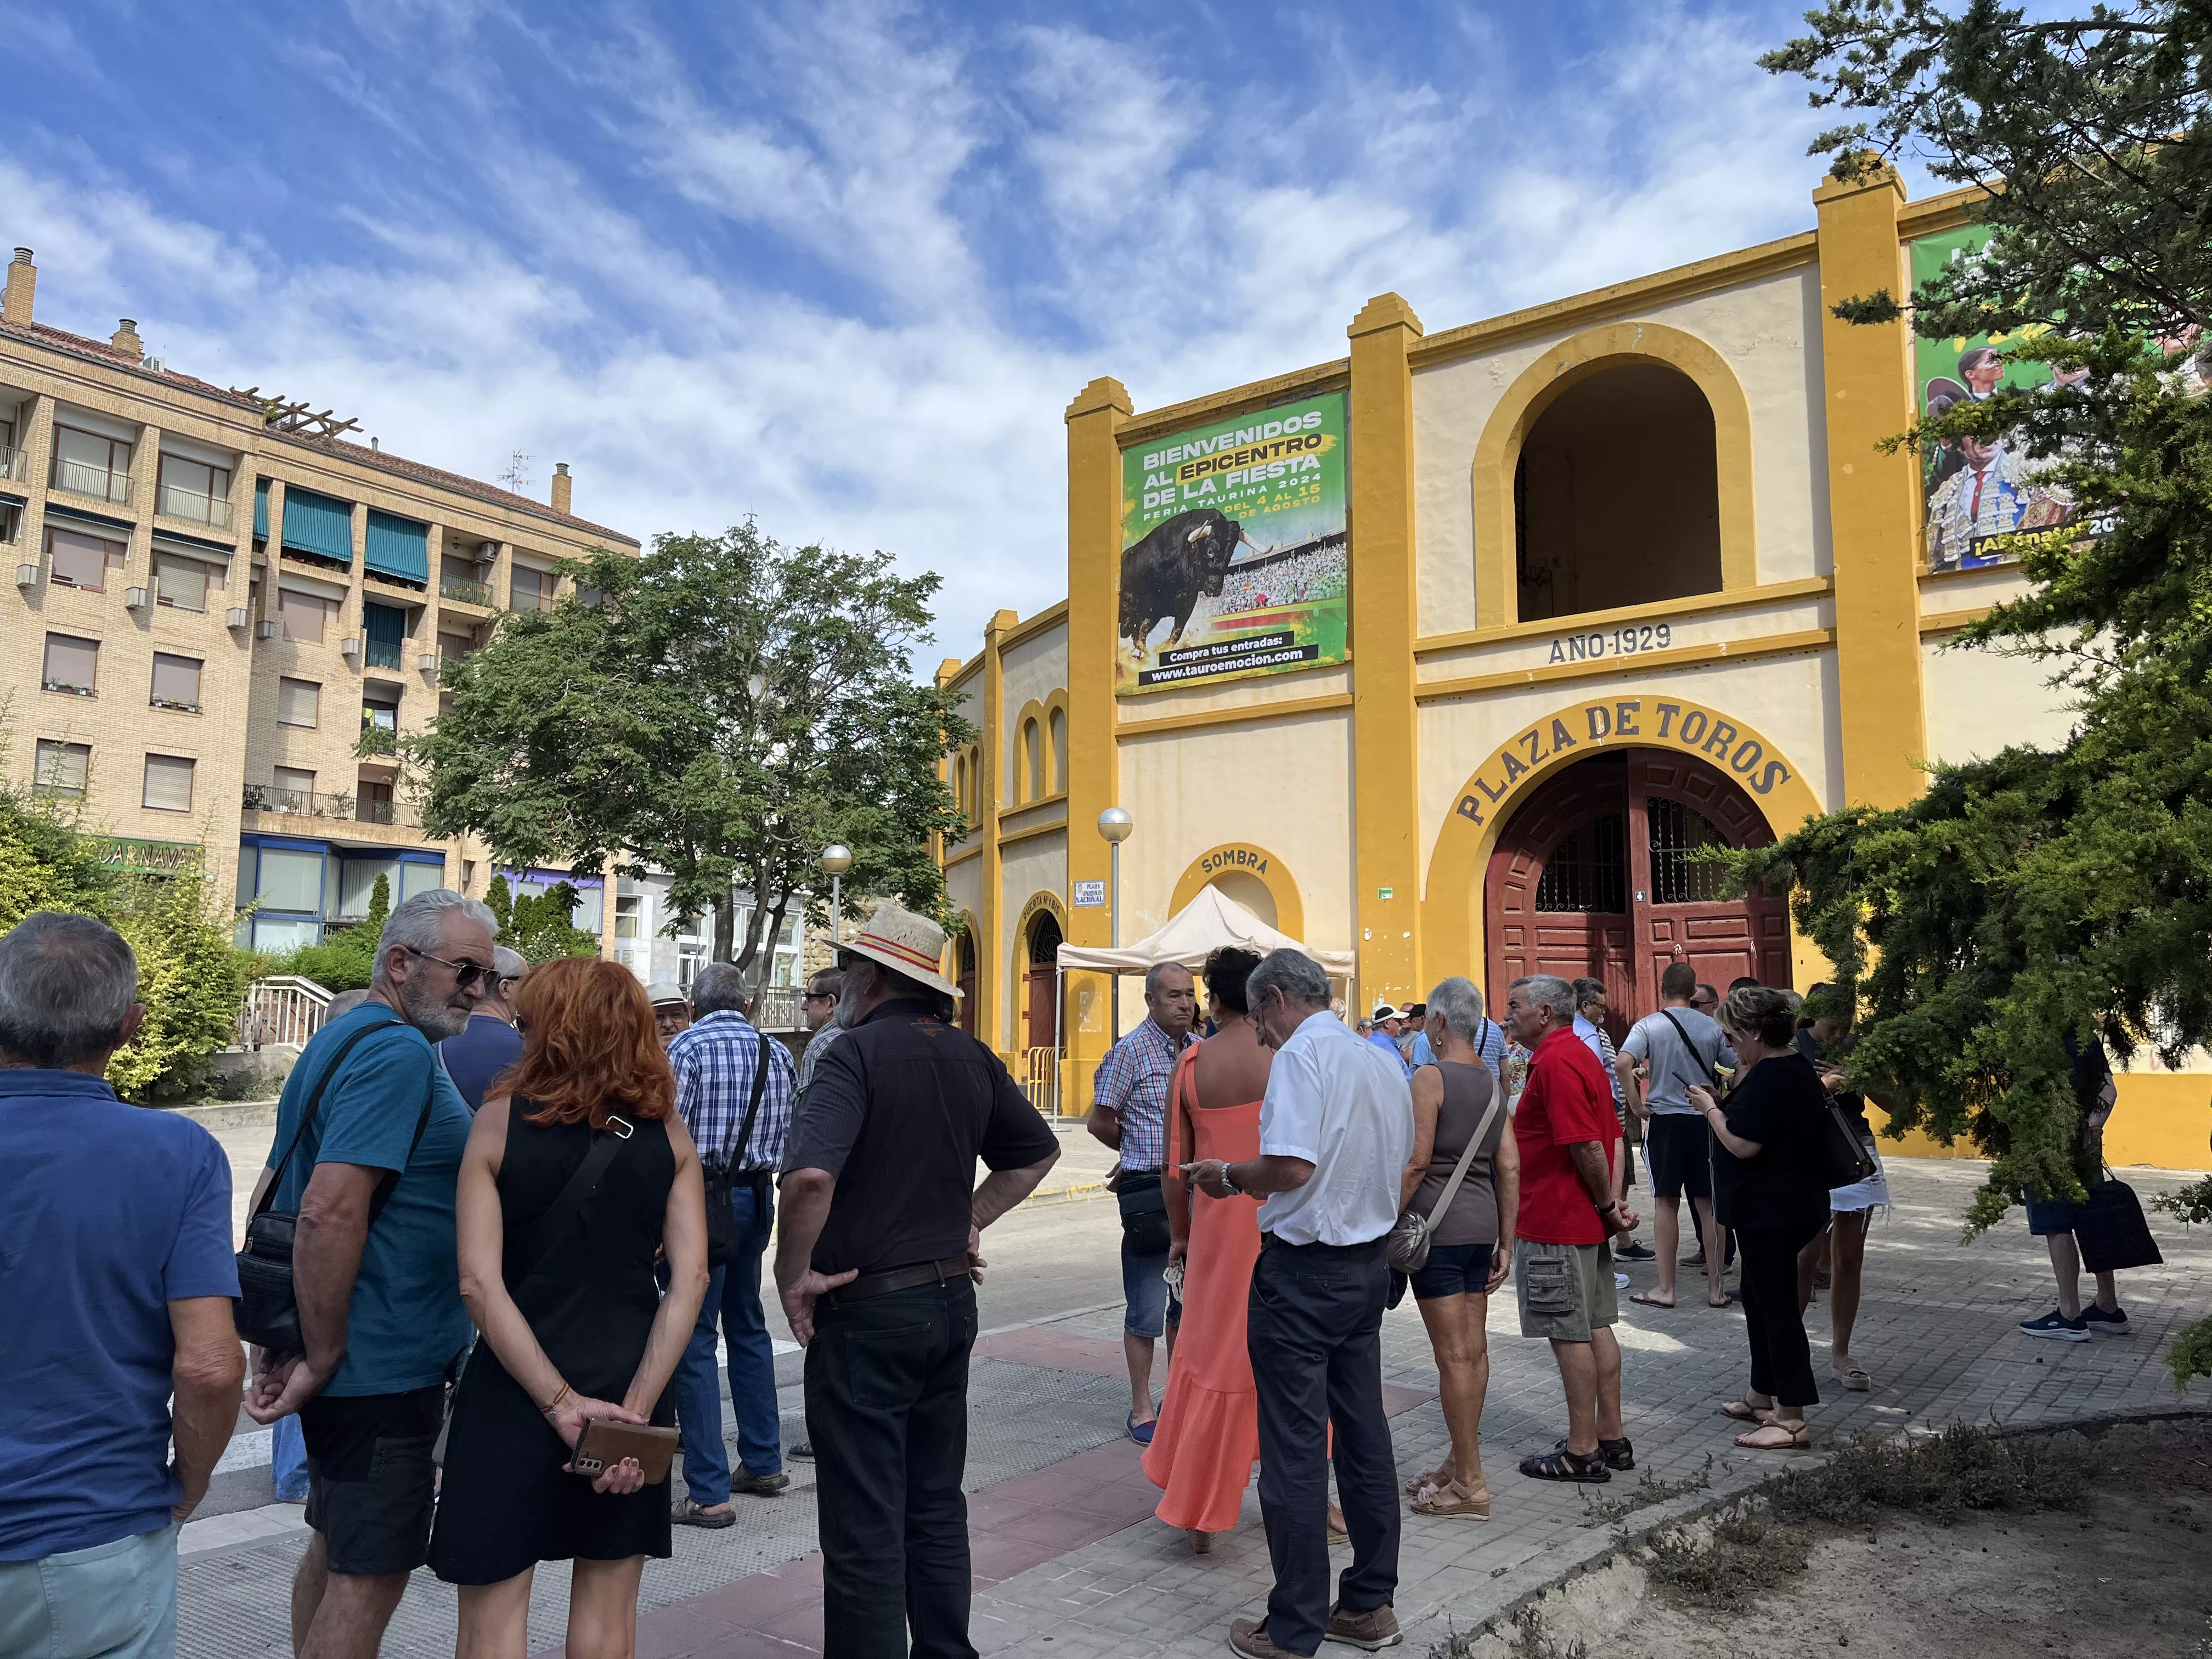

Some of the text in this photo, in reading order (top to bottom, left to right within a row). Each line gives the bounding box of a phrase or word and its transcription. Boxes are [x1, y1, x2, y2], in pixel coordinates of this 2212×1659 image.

[1143, 411, 1322, 471] BIENVENIDOS
[1143, 433, 1322, 490] AL EPICENTRO
[1143, 453, 1321, 509] DE LA FIESTA
[1143, 473, 1321, 521] FERIA TAURINA 2024
[1224, 483, 1321, 514] DEL 4 AL 15
[1239, 495, 1321, 520] DE AGOSTO
[1151, 649, 1303, 681] www.tauroemocion.com
[1170, 636, 1283, 663] Compra tus entradas:
[1456, 702, 1792, 827] PLAZA DE TOROS
[1201, 849, 1268, 874] SOMBRA
[1023, 895, 1042, 922] PUERTA
[1051, 899, 1060, 915] BIS
